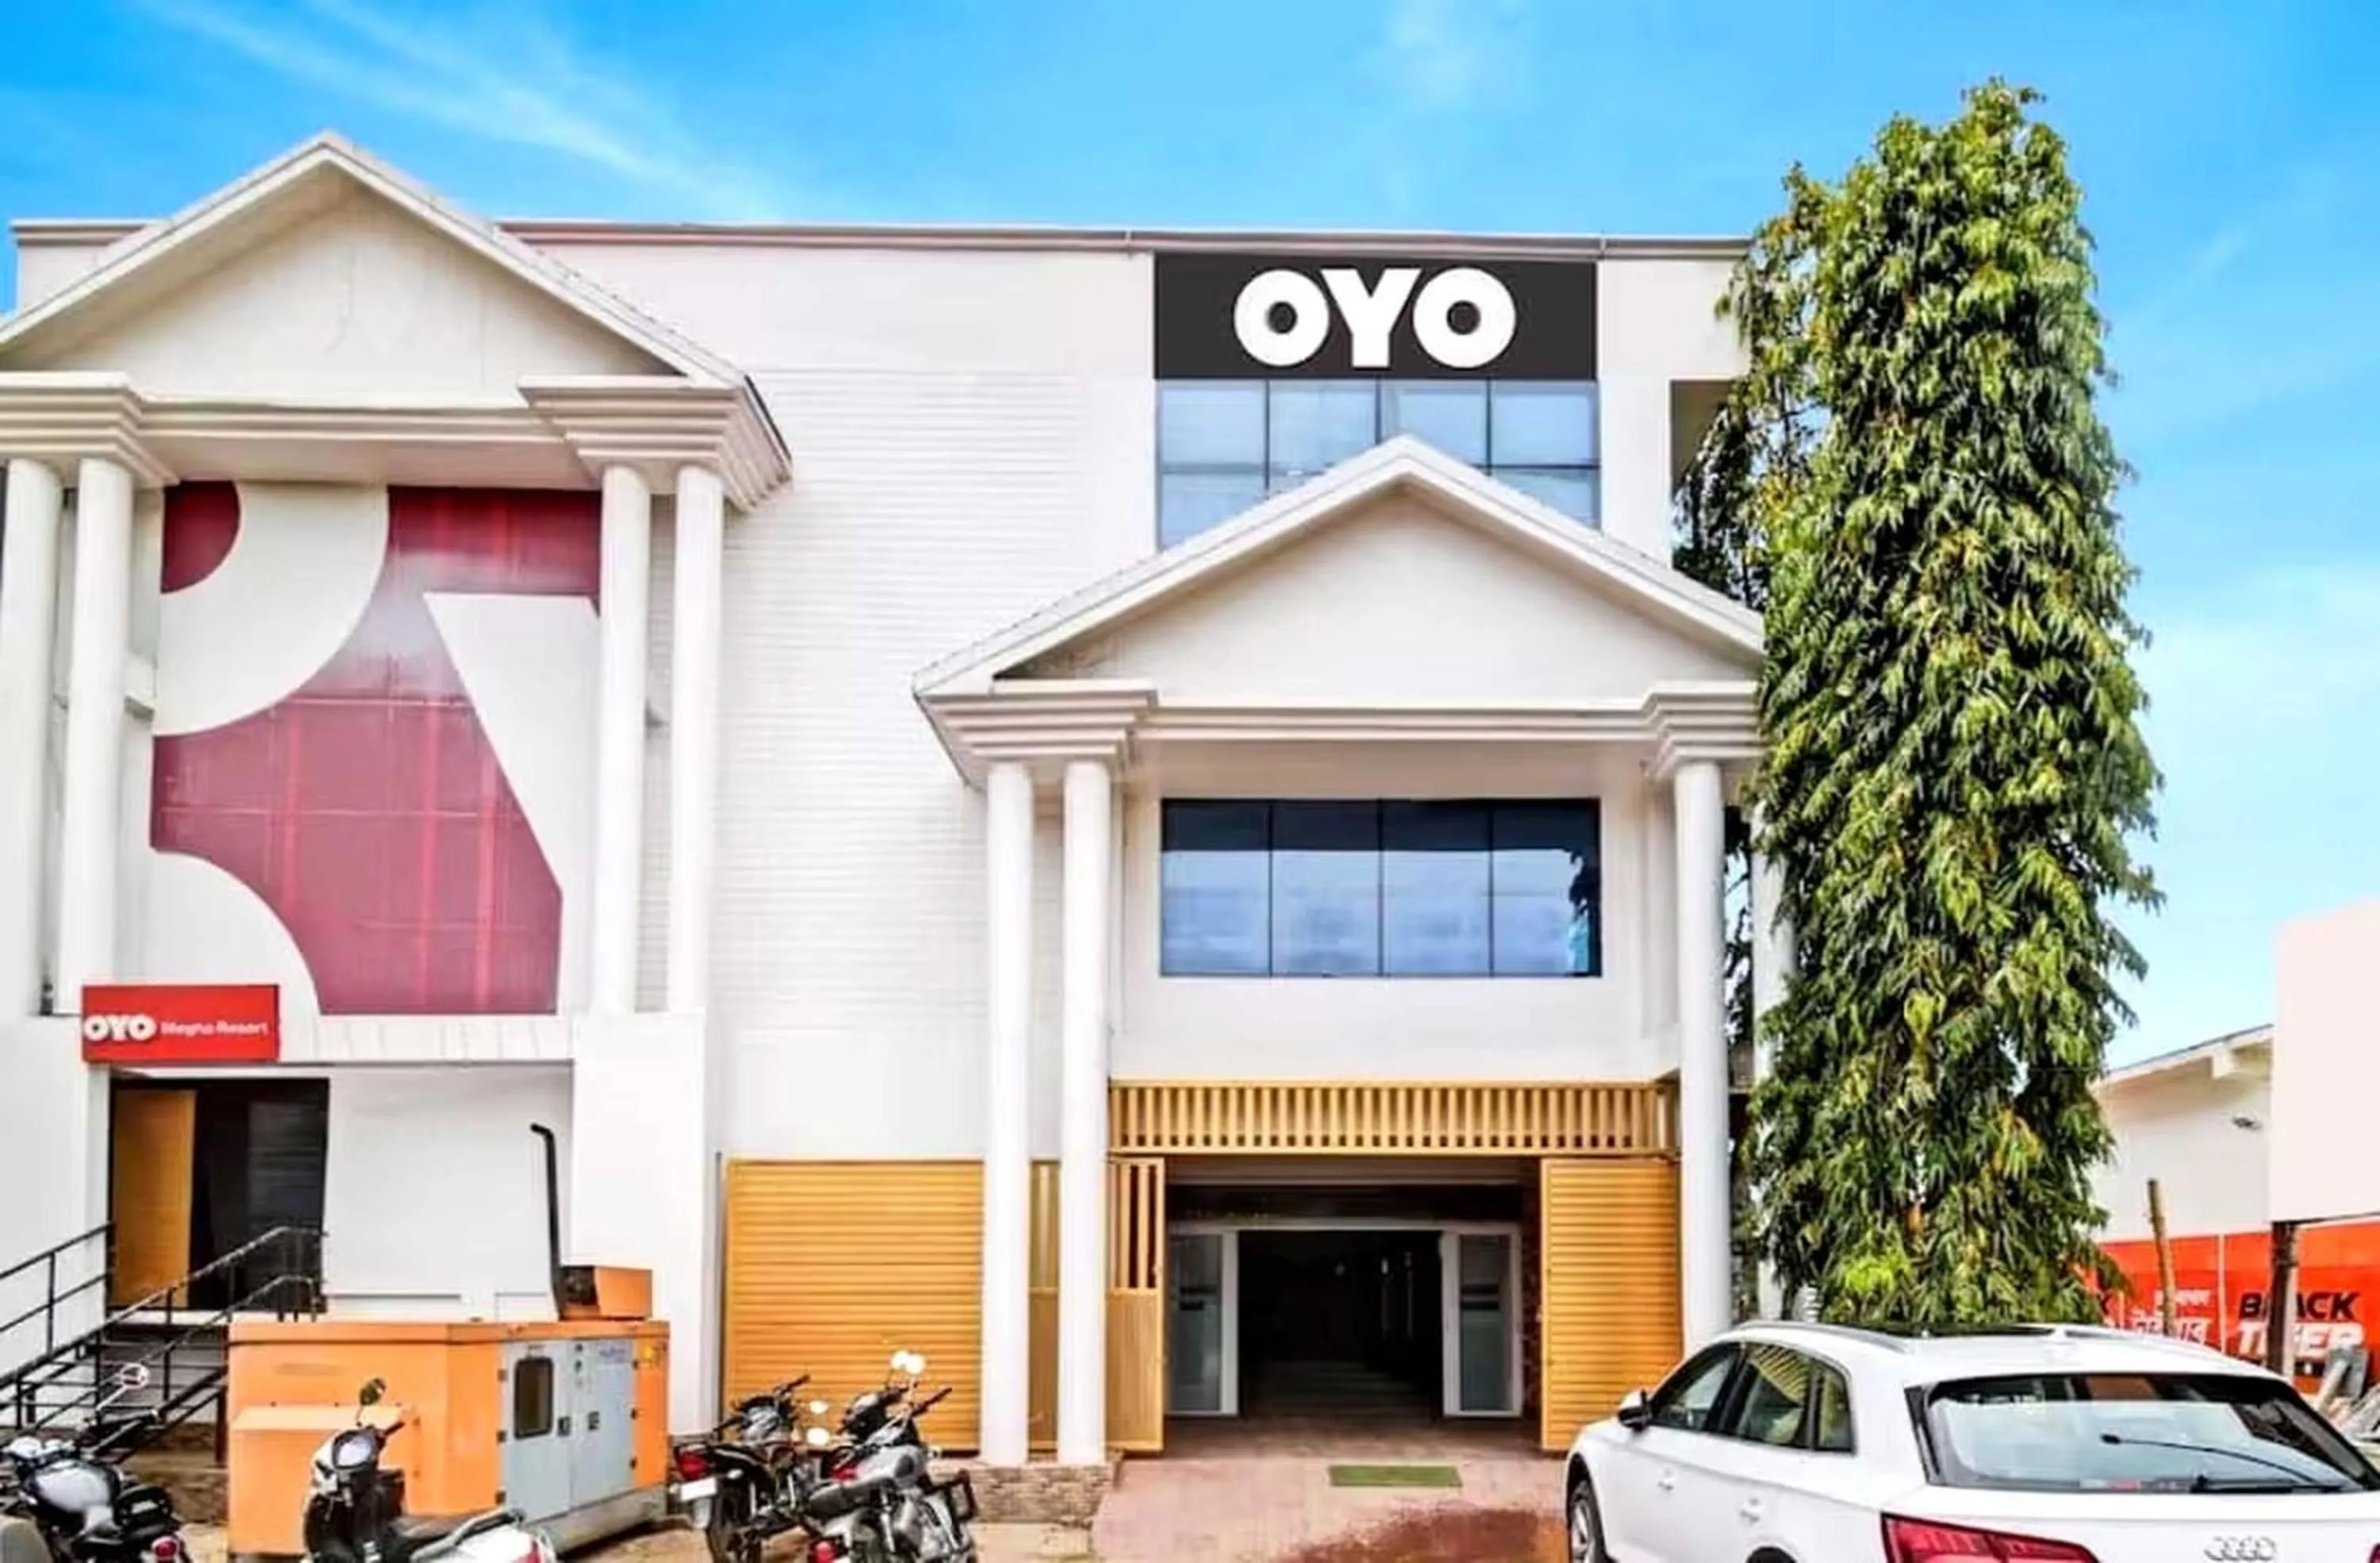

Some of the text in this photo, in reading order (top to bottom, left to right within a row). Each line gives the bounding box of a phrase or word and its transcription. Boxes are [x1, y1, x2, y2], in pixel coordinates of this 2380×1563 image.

[1234, 267, 1516, 369] OYO
[84, 1014, 156, 1041] OYO
[2240, 1292, 2359, 1320] BCK
